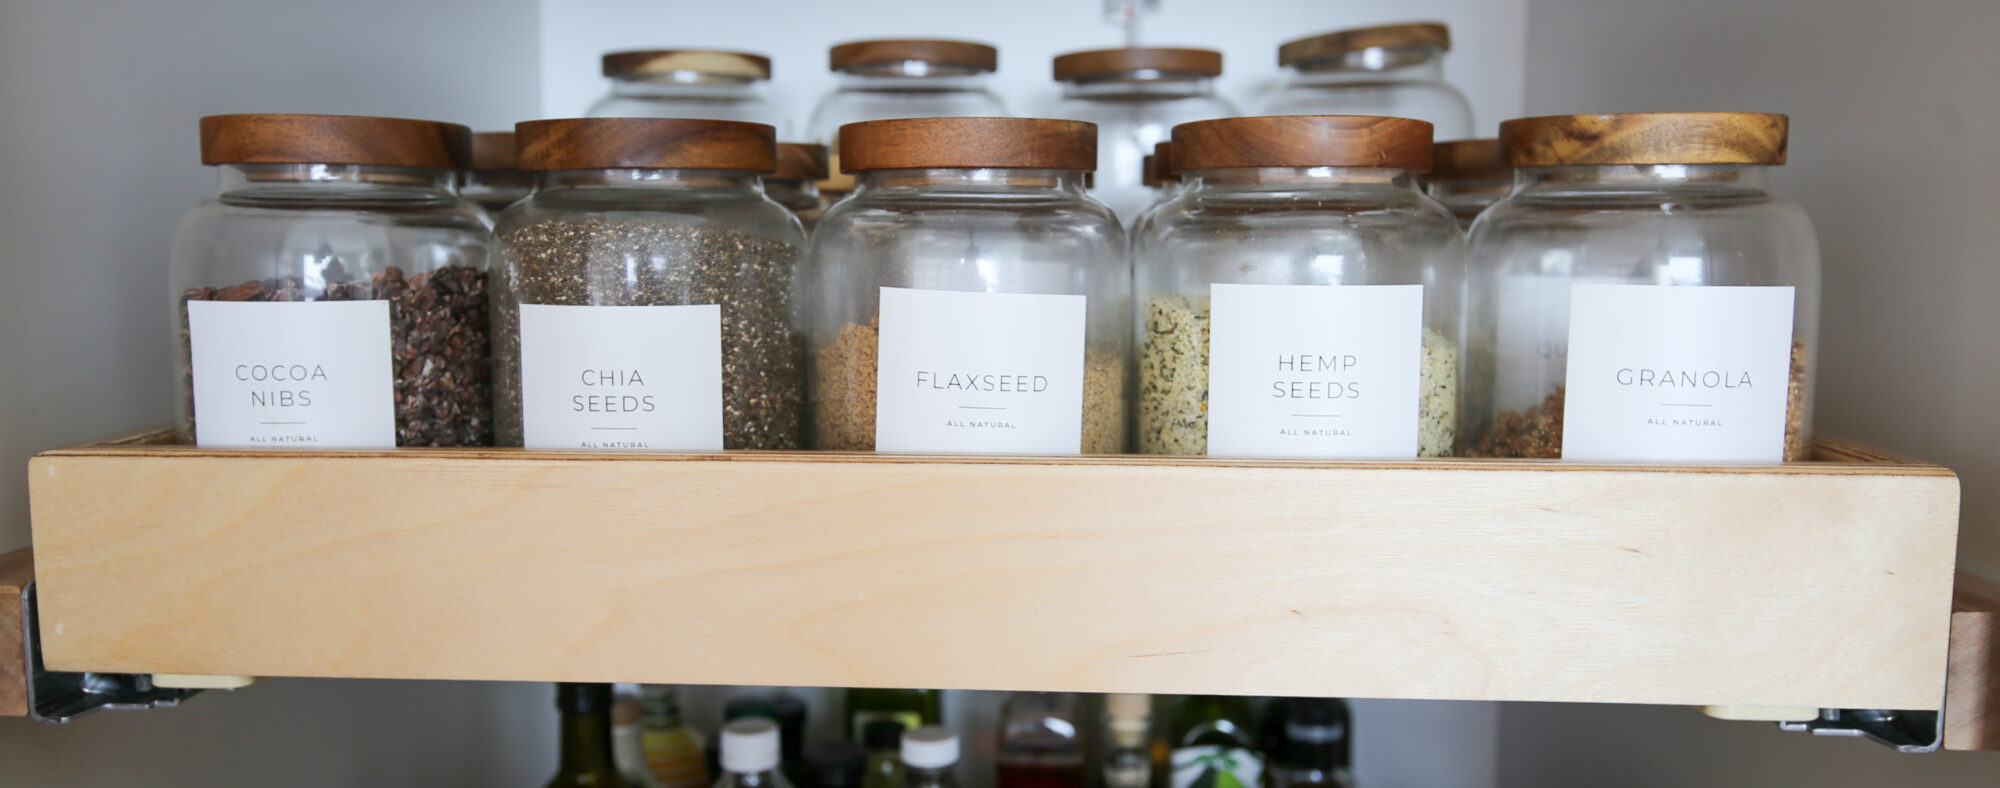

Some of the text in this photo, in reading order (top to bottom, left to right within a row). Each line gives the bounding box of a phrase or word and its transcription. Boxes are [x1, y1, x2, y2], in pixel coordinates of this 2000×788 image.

[234, 364, 328, 382] COCOA
[1279, 354, 1357, 373] HEMP
[581, 368, 645, 387] CHIA
[916, 370, 1048, 393] FLAXSEED
[1616, 367, 1753, 389] GRANOLA
[251, 390, 312, 408] NIBS
[1272, 380, 1360, 400] SEEDS
[572, 394, 656, 413] SEEDS
[946, 420, 1017, 429] ALL NATURAL
[1647, 417, 1723, 427] ALL NATURAL
[1279, 428, 1352, 437] ALL NATURAL
